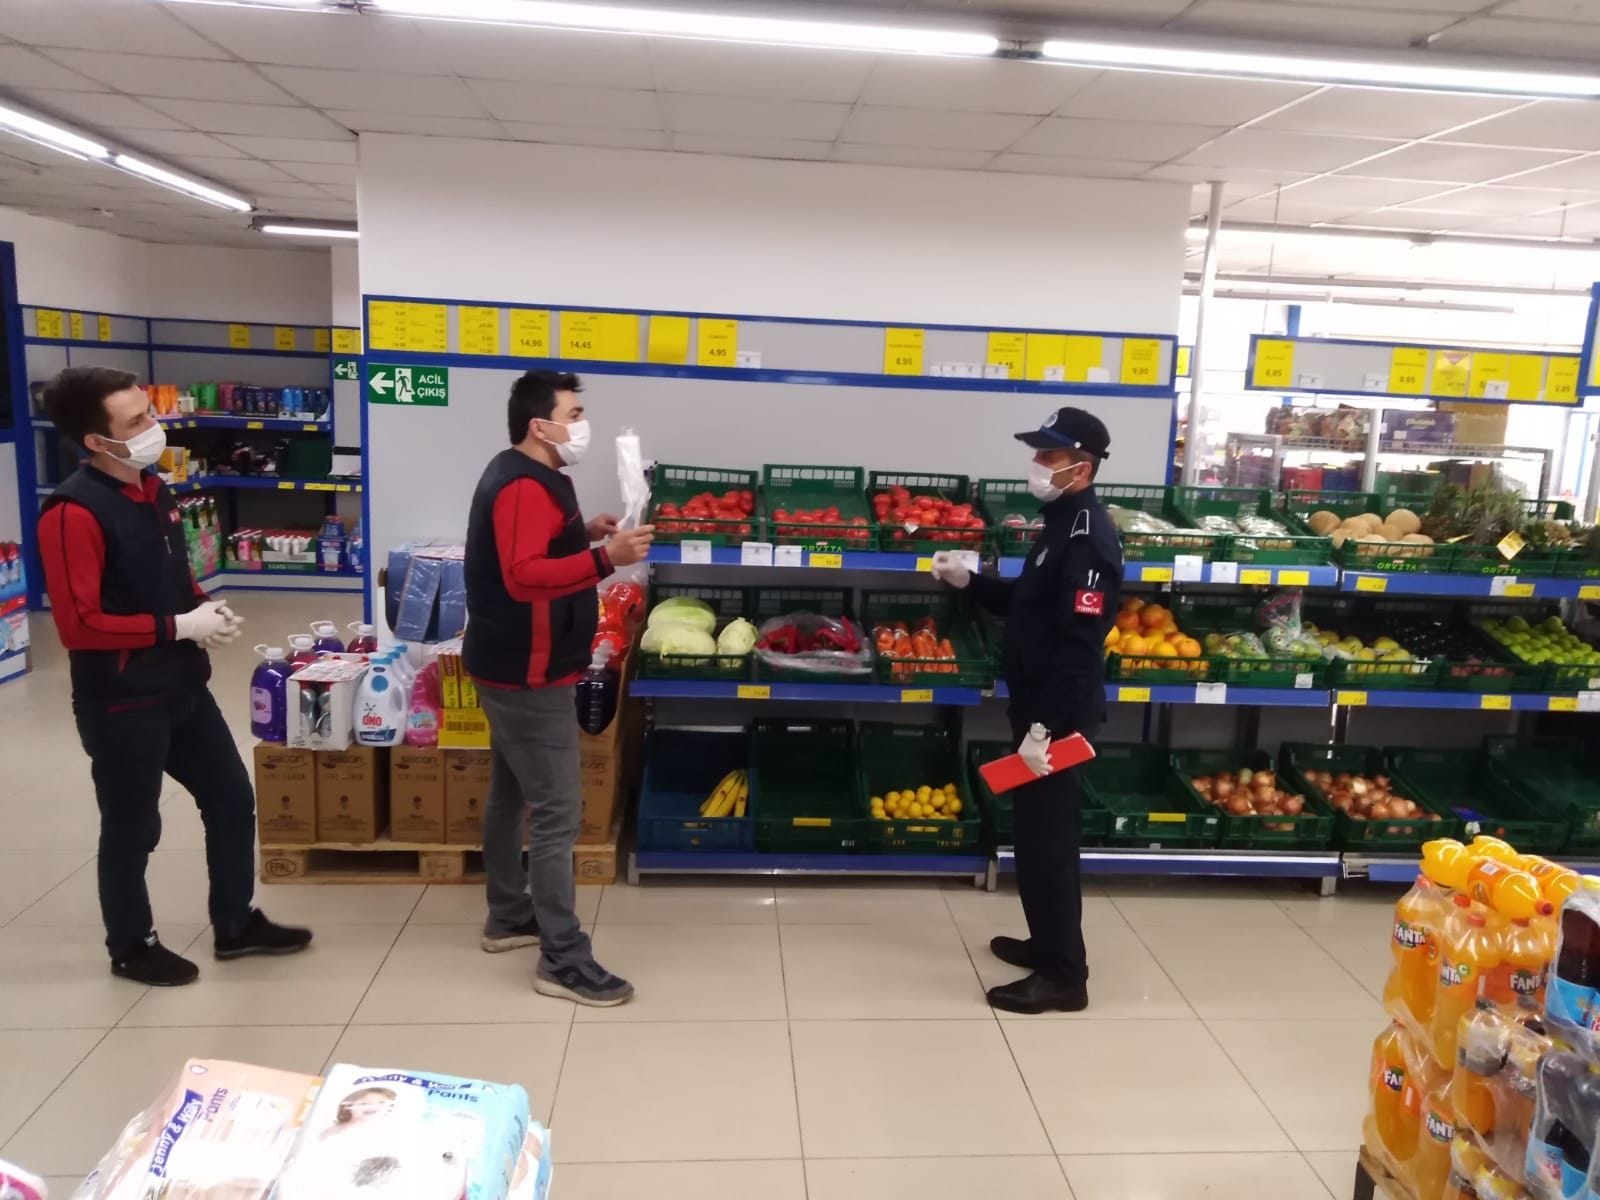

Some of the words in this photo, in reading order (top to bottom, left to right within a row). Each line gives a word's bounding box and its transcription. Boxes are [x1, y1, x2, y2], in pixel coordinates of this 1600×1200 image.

[418, 373, 445, 385] ACİL
[416, 387, 446, 399] ÇIKIŞ
[362, 715, 382, 727] OMO
[427, 1088, 479, 1103] Pants
[167, 1122, 184, 1134] &
